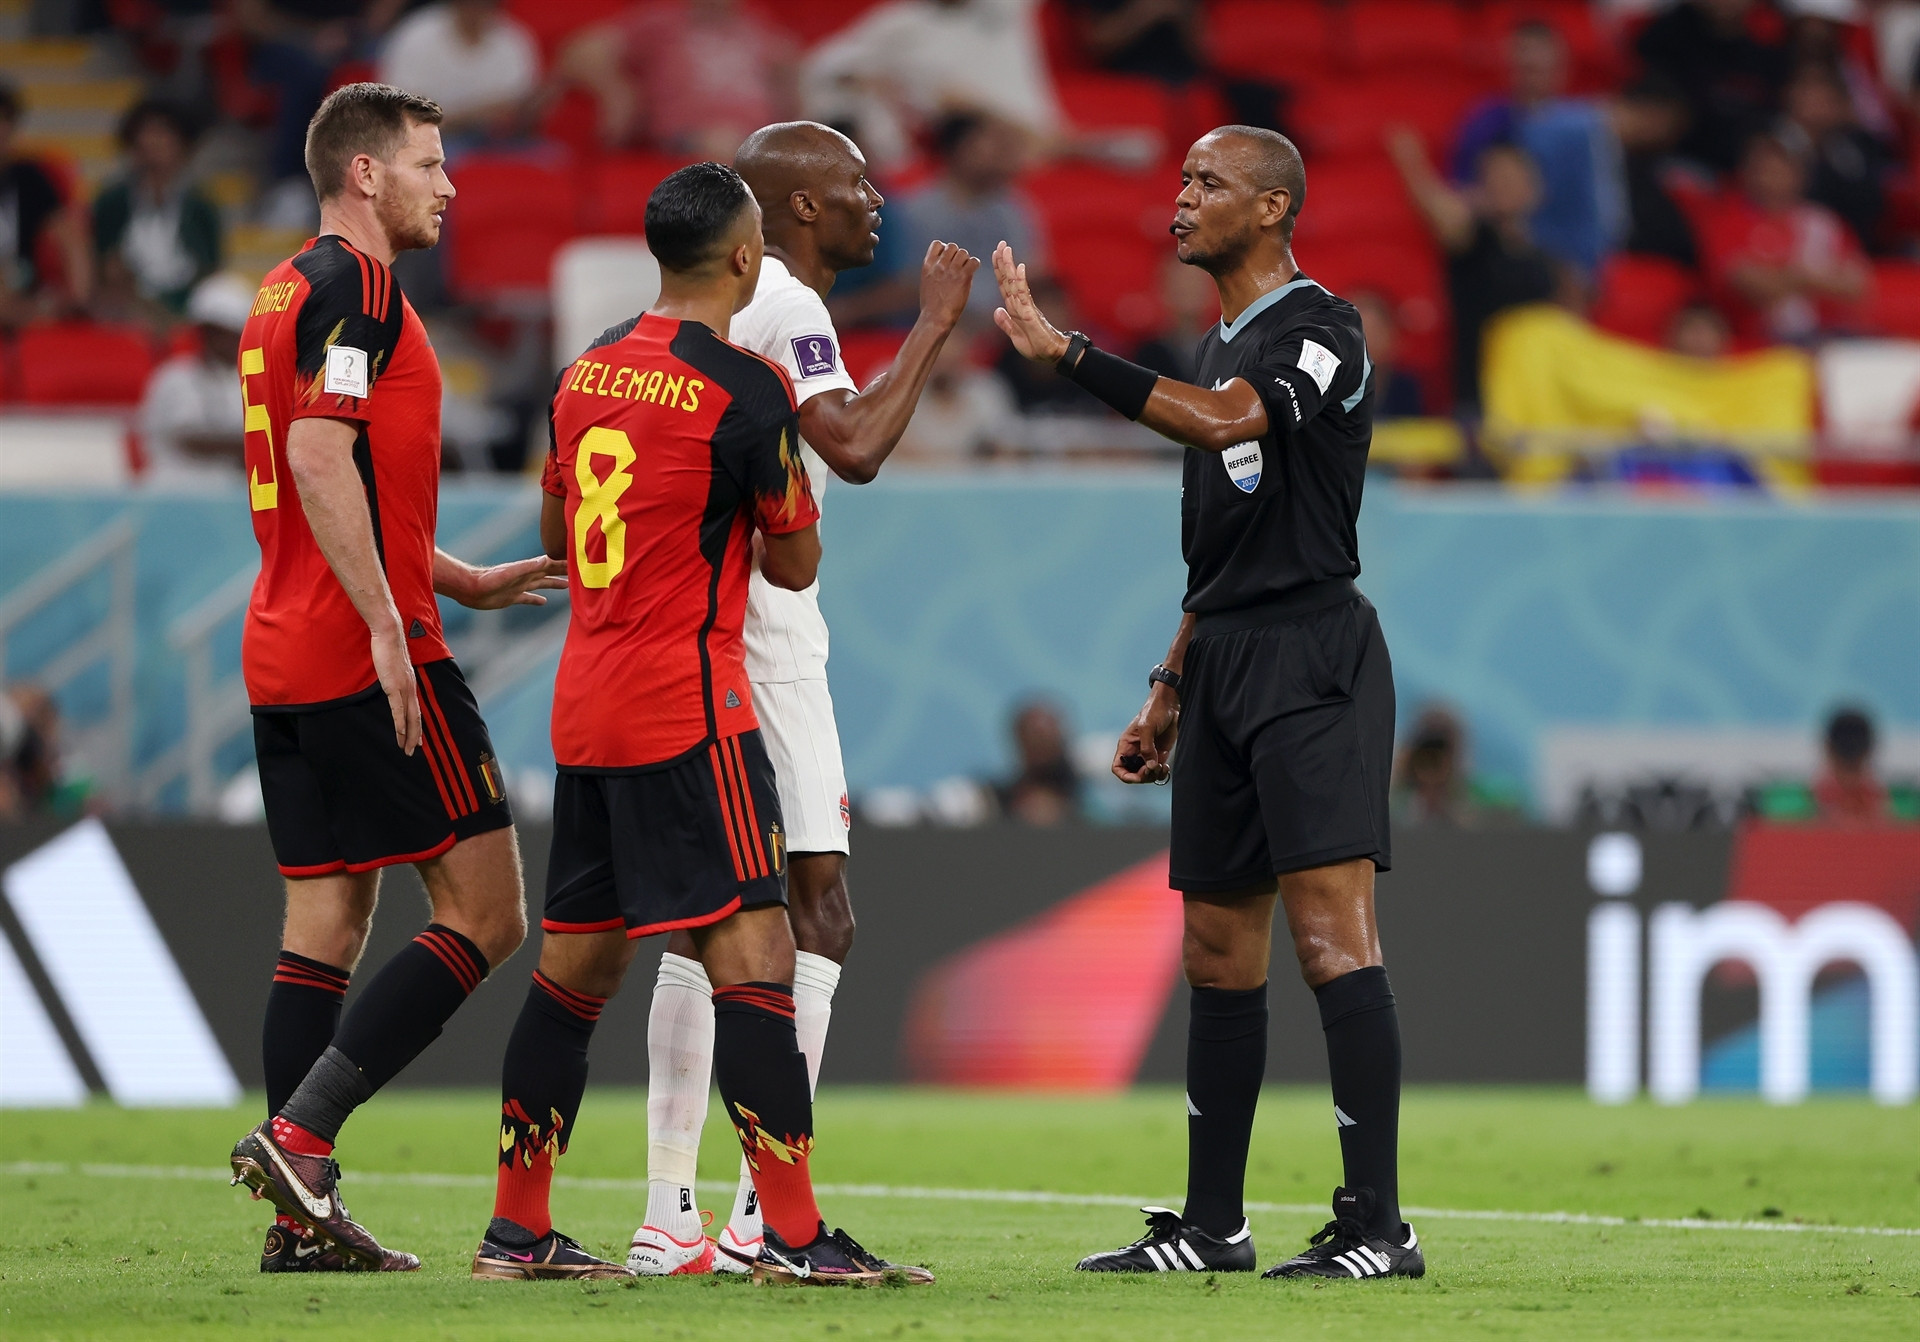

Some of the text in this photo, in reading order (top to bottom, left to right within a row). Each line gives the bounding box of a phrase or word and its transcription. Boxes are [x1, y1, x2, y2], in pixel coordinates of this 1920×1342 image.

[248, 281, 300, 318] TONGHEN
[566, 359, 705, 413] TIELEMANS
[1274, 377, 1302, 423] TEAM ONE
[241, 346, 279, 512] 5
[1227, 453, 1260, 471] REFEREE
[1241, 477, 1256, 488] 2022
[574, 426, 637, 589] 8
